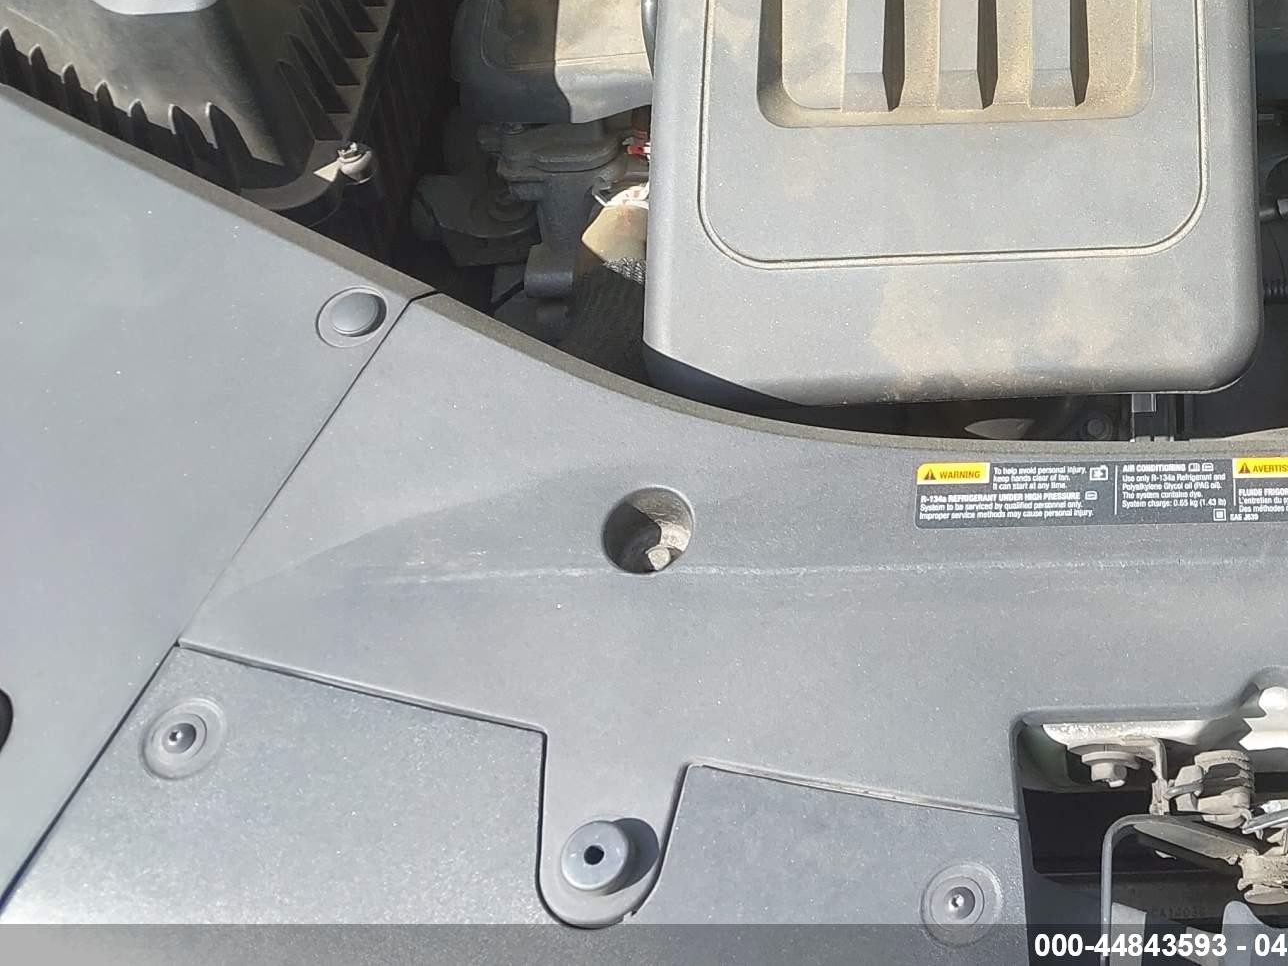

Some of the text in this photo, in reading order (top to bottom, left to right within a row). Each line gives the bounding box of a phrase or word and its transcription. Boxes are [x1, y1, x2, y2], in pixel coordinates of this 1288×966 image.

[1019, 466, 1037, 474] avoid
[1037, 466, 1066, 475] personal
[1122, 463, 1186, 472] AIR CONDITIONING
[940, 470, 981, 479] WARNING
[1032, 474, 1048, 482] clear
[1122, 473, 1226, 483] Use only R-134a Refrigerant and
[1012, 482, 1028, 490] start
[1037, 482, 1049, 491] any
[1122, 483, 1162, 492] Polyalkylene
[1163, 482, 1183, 491] Glycol
[1136, 491, 1159, 500] system
[1238, 488, 1262, 496] FLUIDE
[920, 491, 1080, 503] R-134a REFRIGERANT UNDER HIGH PRESSURE
[1273, 496, 1282, 504] du
[919, 503, 945, 512] System
[946, 503, 953, 511] to
[994, 502, 1002, 511] by
[1004, 501, 1033, 510] qualified
[1034, 501, 1066, 510] personnel
[1122, 500, 1146, 509] System
[1147, 499, 1172, 508] charge:
[1189, 498, 1198, 508] kg
[1199, 498, 1217, 507] (1.43
[1217, 498, 1227, 506] lb)
[1239, 505, 1252, 513] Des
[919, 512, 949, 522] Improper
[976, 511, 1006, 519] methods
[1007, 511, 1021, 520] may
[1044, 509, 1073, 519] personal
